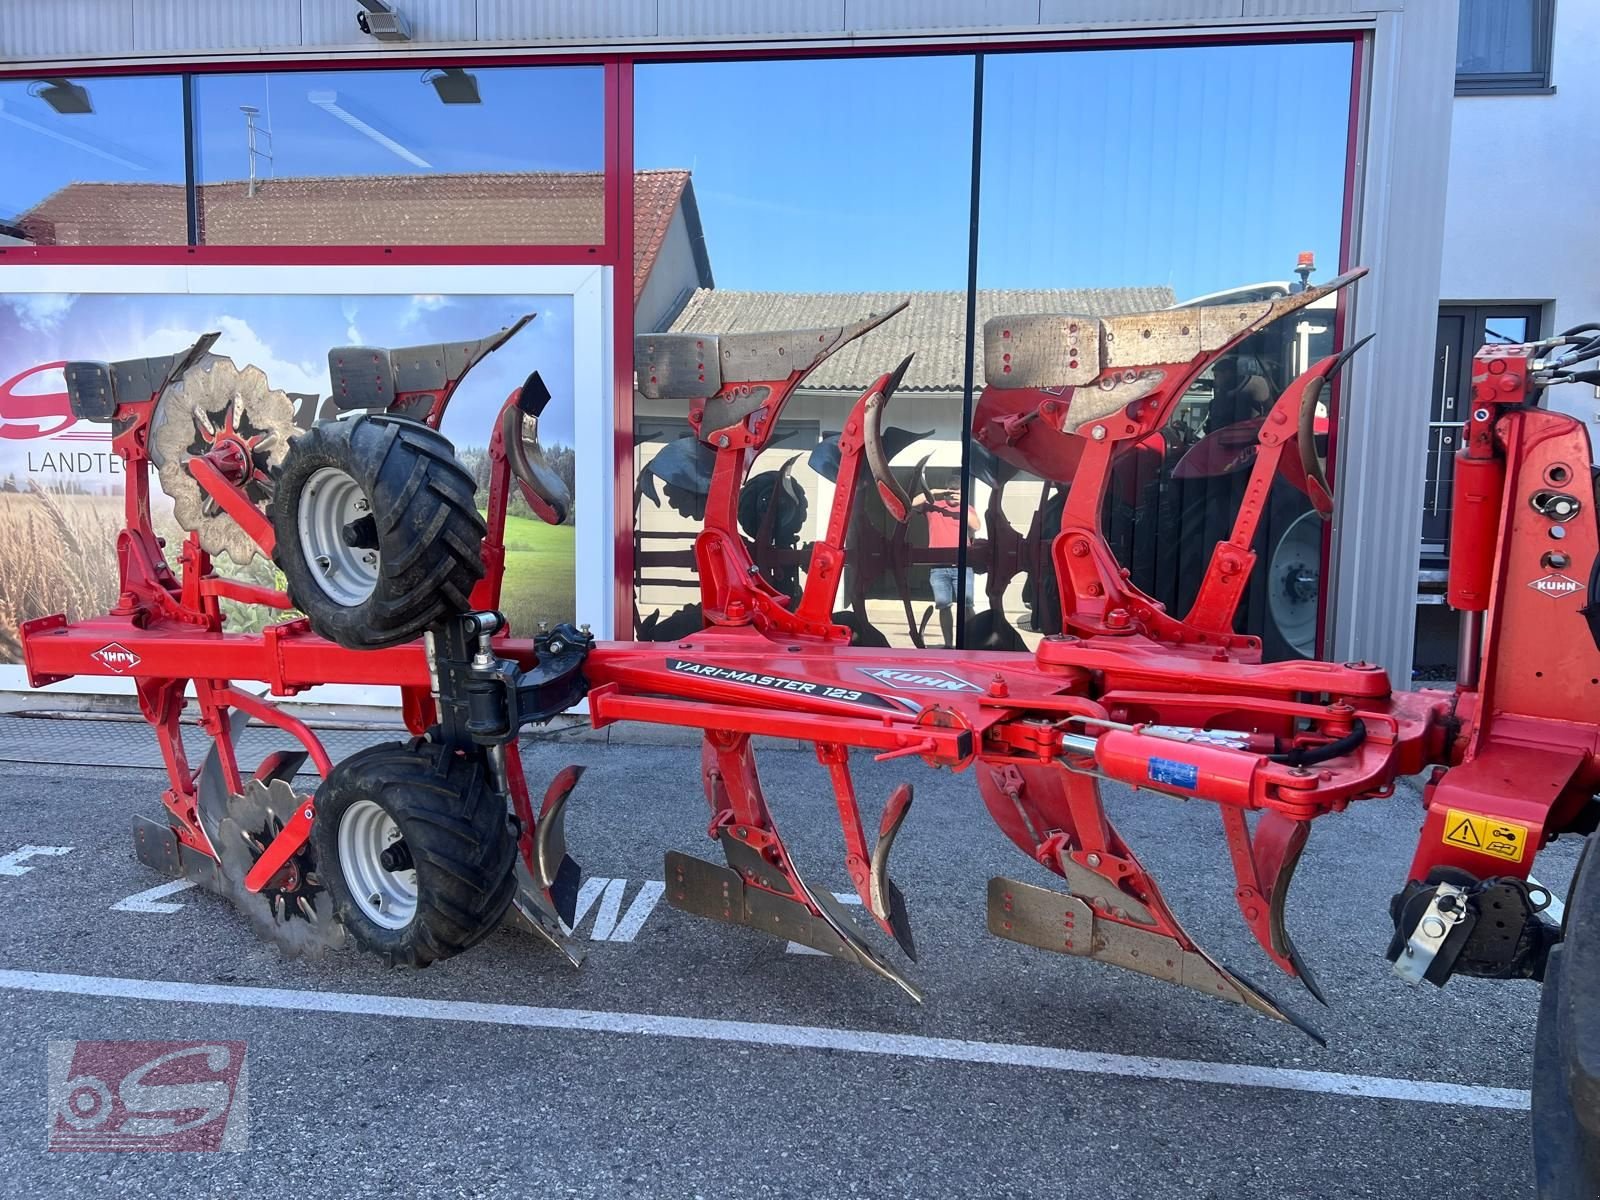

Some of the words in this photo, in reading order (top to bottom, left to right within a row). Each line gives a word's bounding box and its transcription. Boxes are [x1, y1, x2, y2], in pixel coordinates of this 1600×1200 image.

[28, 451, 155, 474] LANDTE
[1537, 581, 1576, 591] KUHN
[674, 661, 817, 693] VARI-MASTER
[822, 686, 863, 701] 123
[872, 669, 969, 690] KUHN
